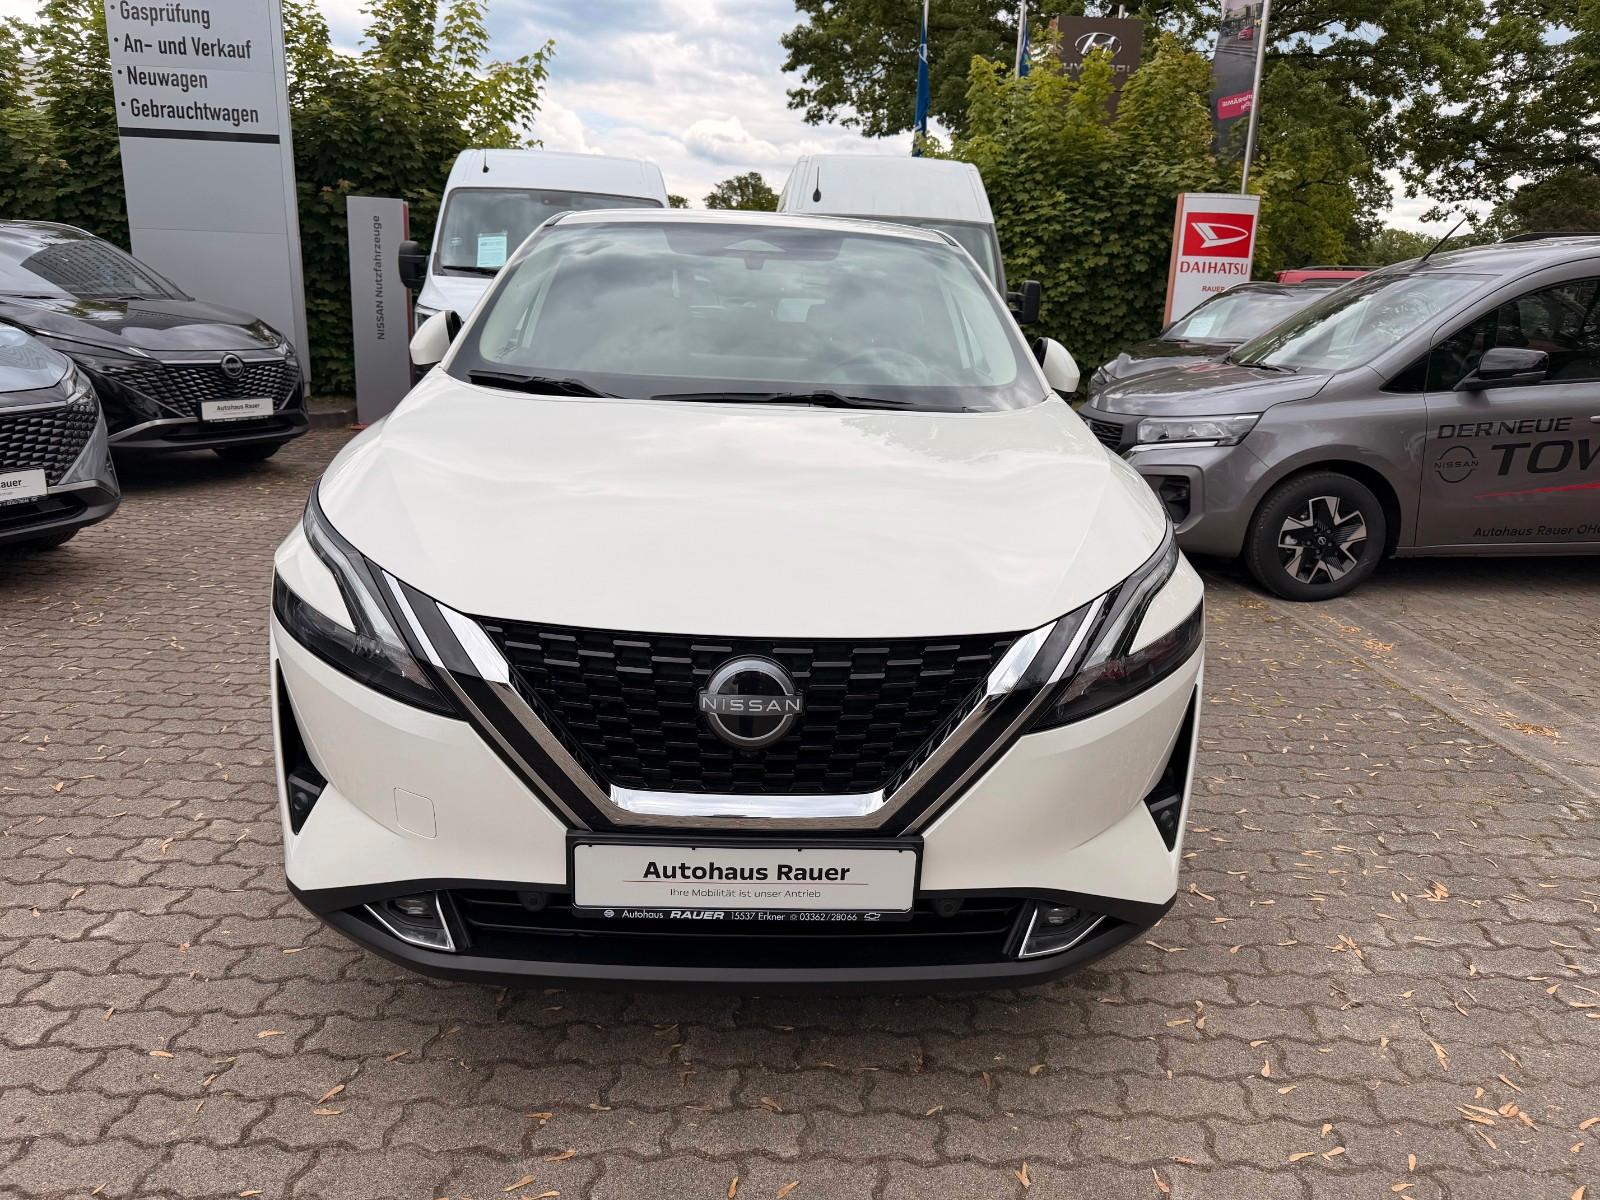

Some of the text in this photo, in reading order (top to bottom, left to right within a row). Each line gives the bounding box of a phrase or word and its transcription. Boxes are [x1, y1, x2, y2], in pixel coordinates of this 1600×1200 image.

[120, 0, 210, 29] Gasprüfung
[124, 33, 251, 59] An- und Verkauf
[127, 66, 208, 92] Neuwagen
[131, 98, 259, 126] Gebrauchtwagen
[1180, 261, 1248, 275] DAIHATSU
[374, 216, 385, 340] NISSAN Nutzfahrzeuge
[1439, 418, 1573, 439] DER NEUE
[1434, 460, 1479, 469] NISSAN
[0, 480, 21, 488] auer
[1473, 527, 1533, 537] Autohaus
[1536, 525, 1573, 536] Rauer
[702, 698, 800, 712] NISSAN
[642, 861, 850, 881] Autohaus Rauer
[670, 888, 821, 898] Ihre Mobilität ist unser Antrieb
[622, 910, 858, 921] Autohaus RAUER 15537 Erkner 03362/28066
